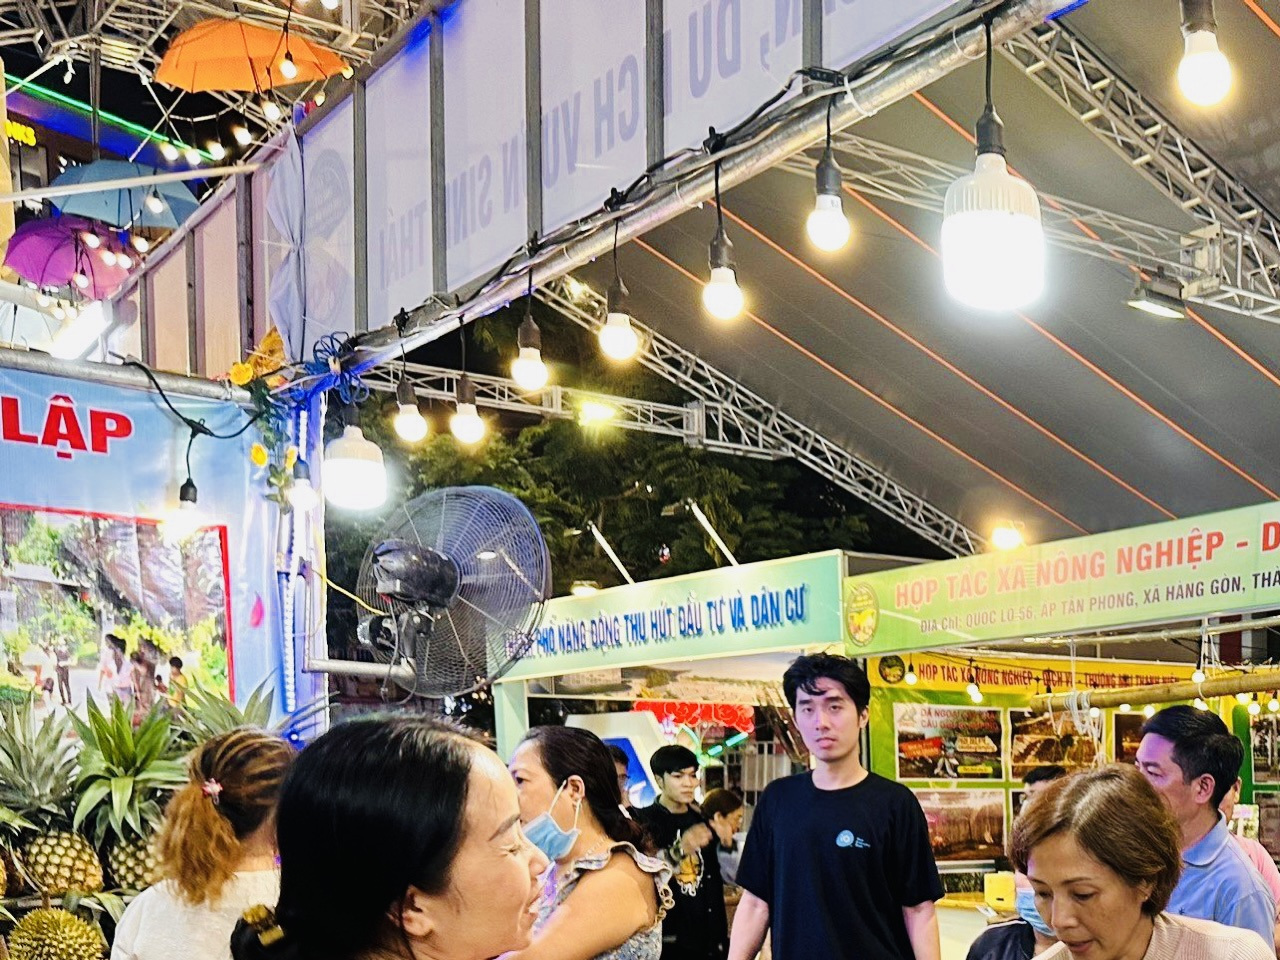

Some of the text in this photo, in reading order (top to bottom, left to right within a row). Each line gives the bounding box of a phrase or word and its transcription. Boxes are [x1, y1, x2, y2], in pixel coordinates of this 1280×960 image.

[1, 394, 132, 459] LẬP
[896, 579, 938, 610] HỢP
[946, 567, 988, 599] TÁC
[1036, 550, 1105, 587] NÔNG
[1117, 528, 1224, 574] NGHIỆP
[1089, 590, 1138, 611] PHONG,
[1143, 584, 1160, 604] XÃ
[1166, 579, 1204, 601] HÀNG
[1210, 573, 1245, 595] GÒN,
[624, 610, 647, 645] THU
[706, 596, 725, 634] TƯ
[729, 589, 747, 631] VÀ
[750, 585, 782, 627] DÂN
[785, 582, 807, 622] CƯ
